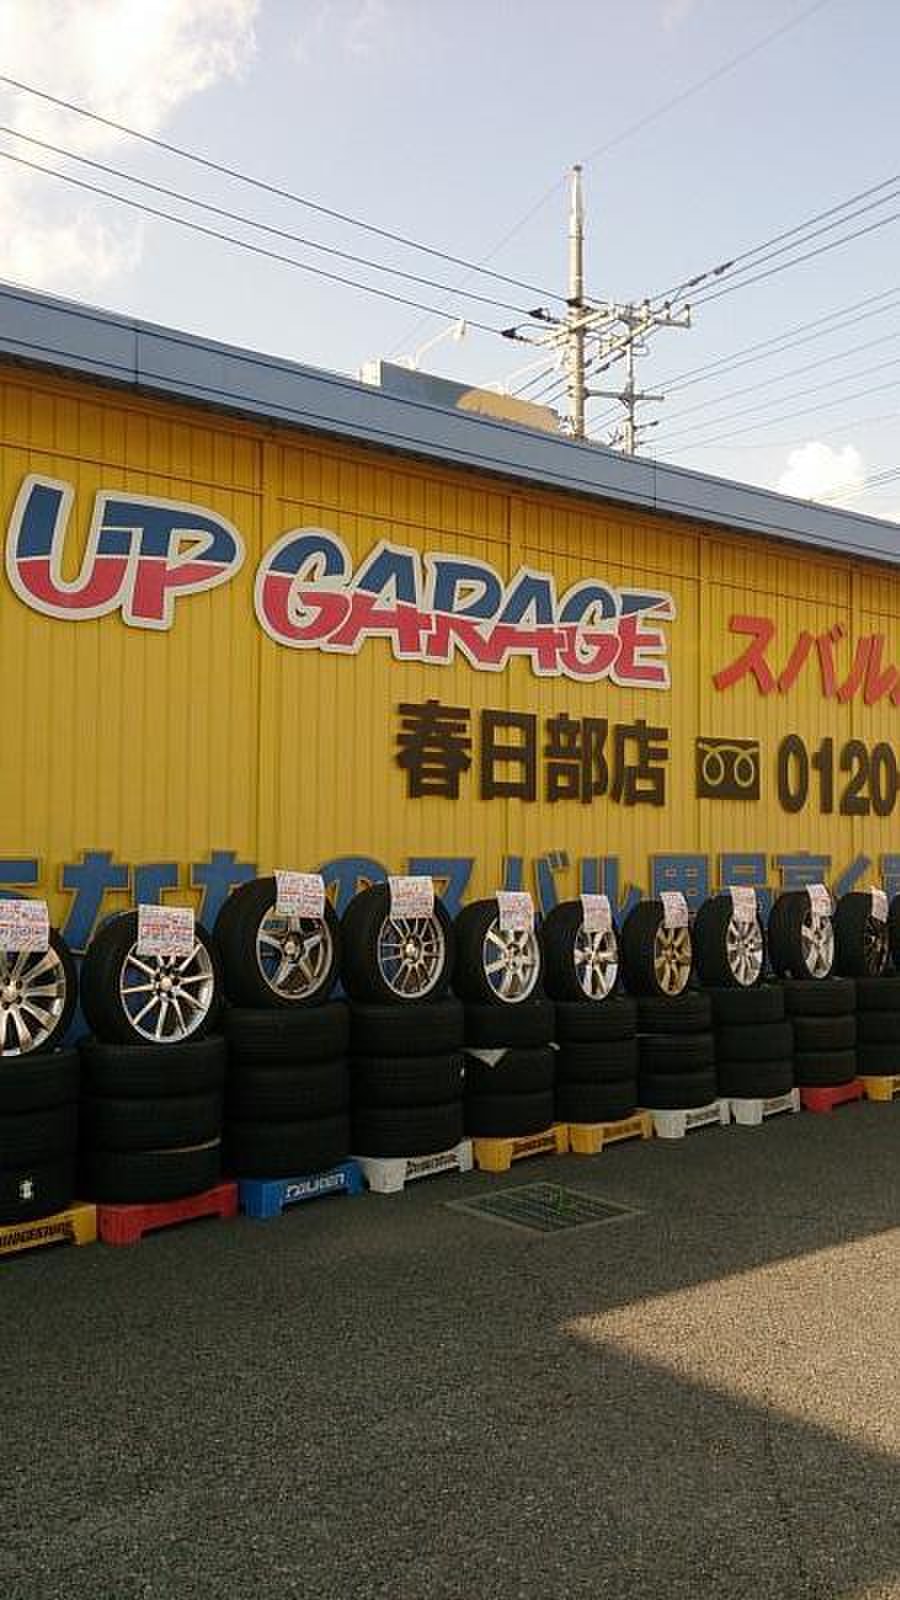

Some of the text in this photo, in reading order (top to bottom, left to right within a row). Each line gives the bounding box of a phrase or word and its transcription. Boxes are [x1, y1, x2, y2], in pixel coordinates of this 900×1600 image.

[7, 474, 676, 690] UP GARAGE
[713, 614, 900, 706] スバル
[396, 699, 670, 806] 春日部店
